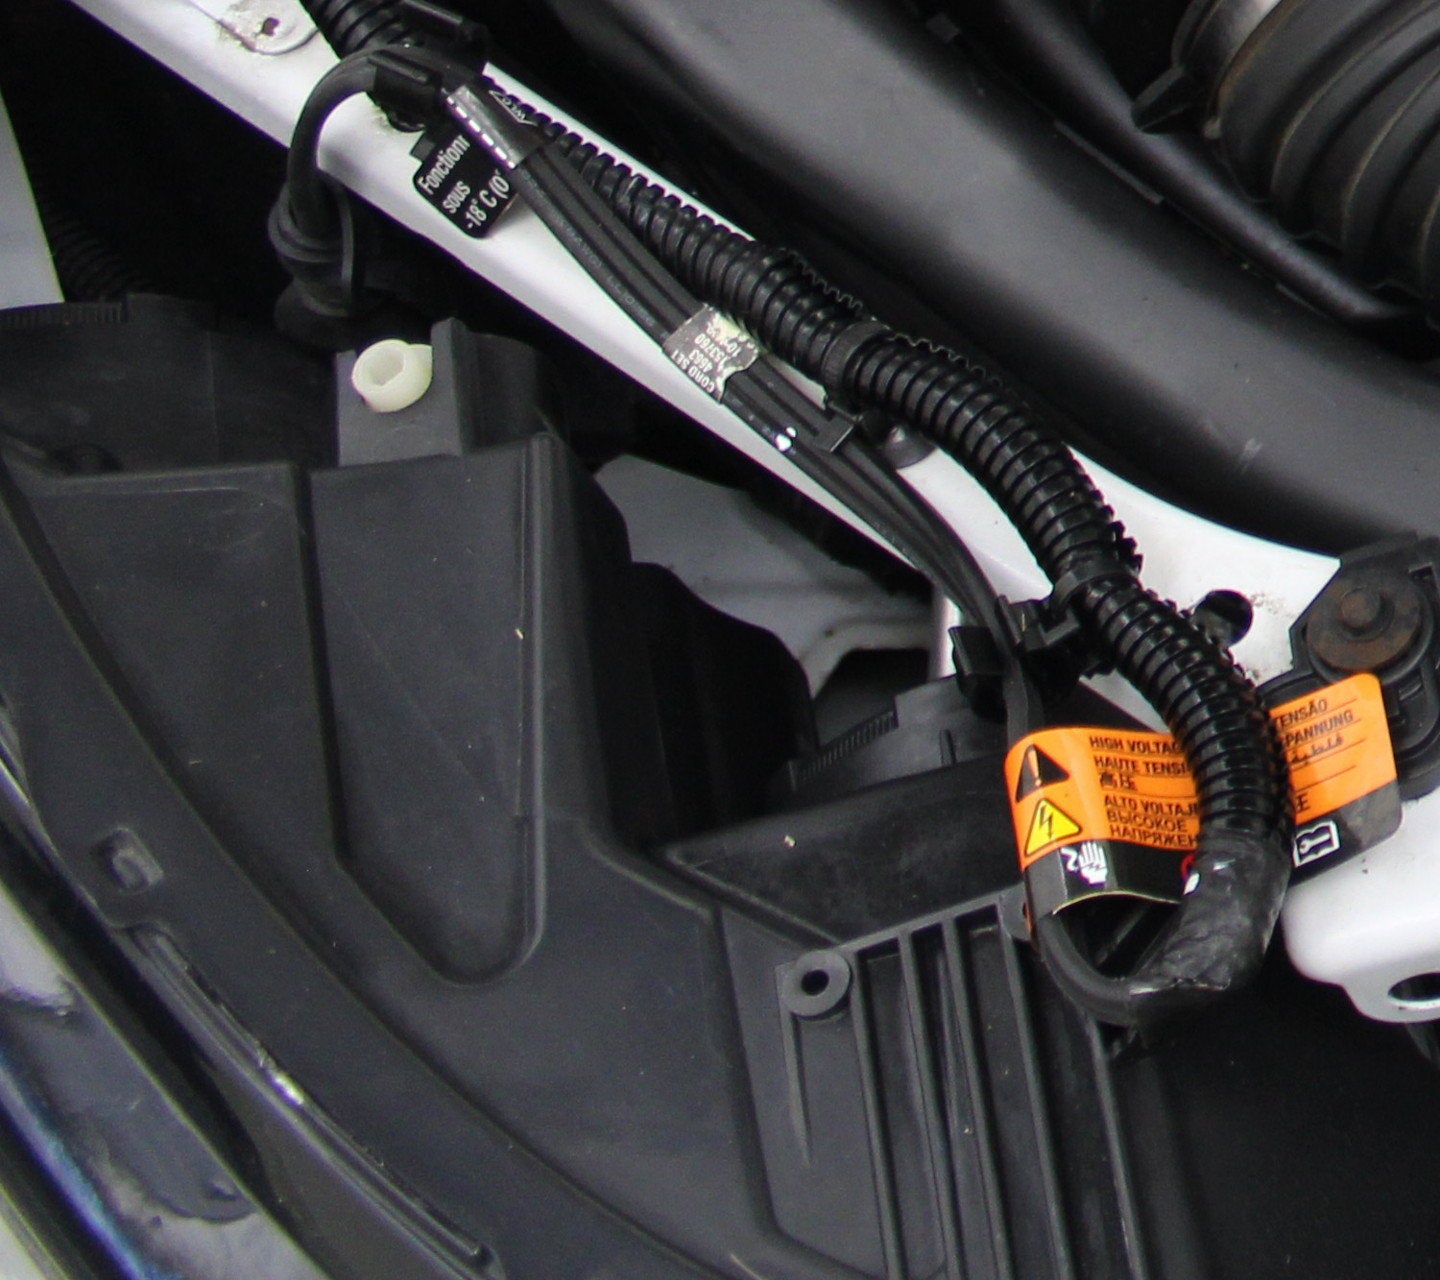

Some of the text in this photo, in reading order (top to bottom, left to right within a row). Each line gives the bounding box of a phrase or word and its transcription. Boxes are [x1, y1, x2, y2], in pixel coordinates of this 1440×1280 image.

[443, 180, 471, 215] sous
[1281, 708, 1354, 747] PANNUNG
[1089, 736, 1124, 751] HIGH
[1093, 756, 1139, 773] HAUTE
[1104, 795, 1138, 811] ALTO
